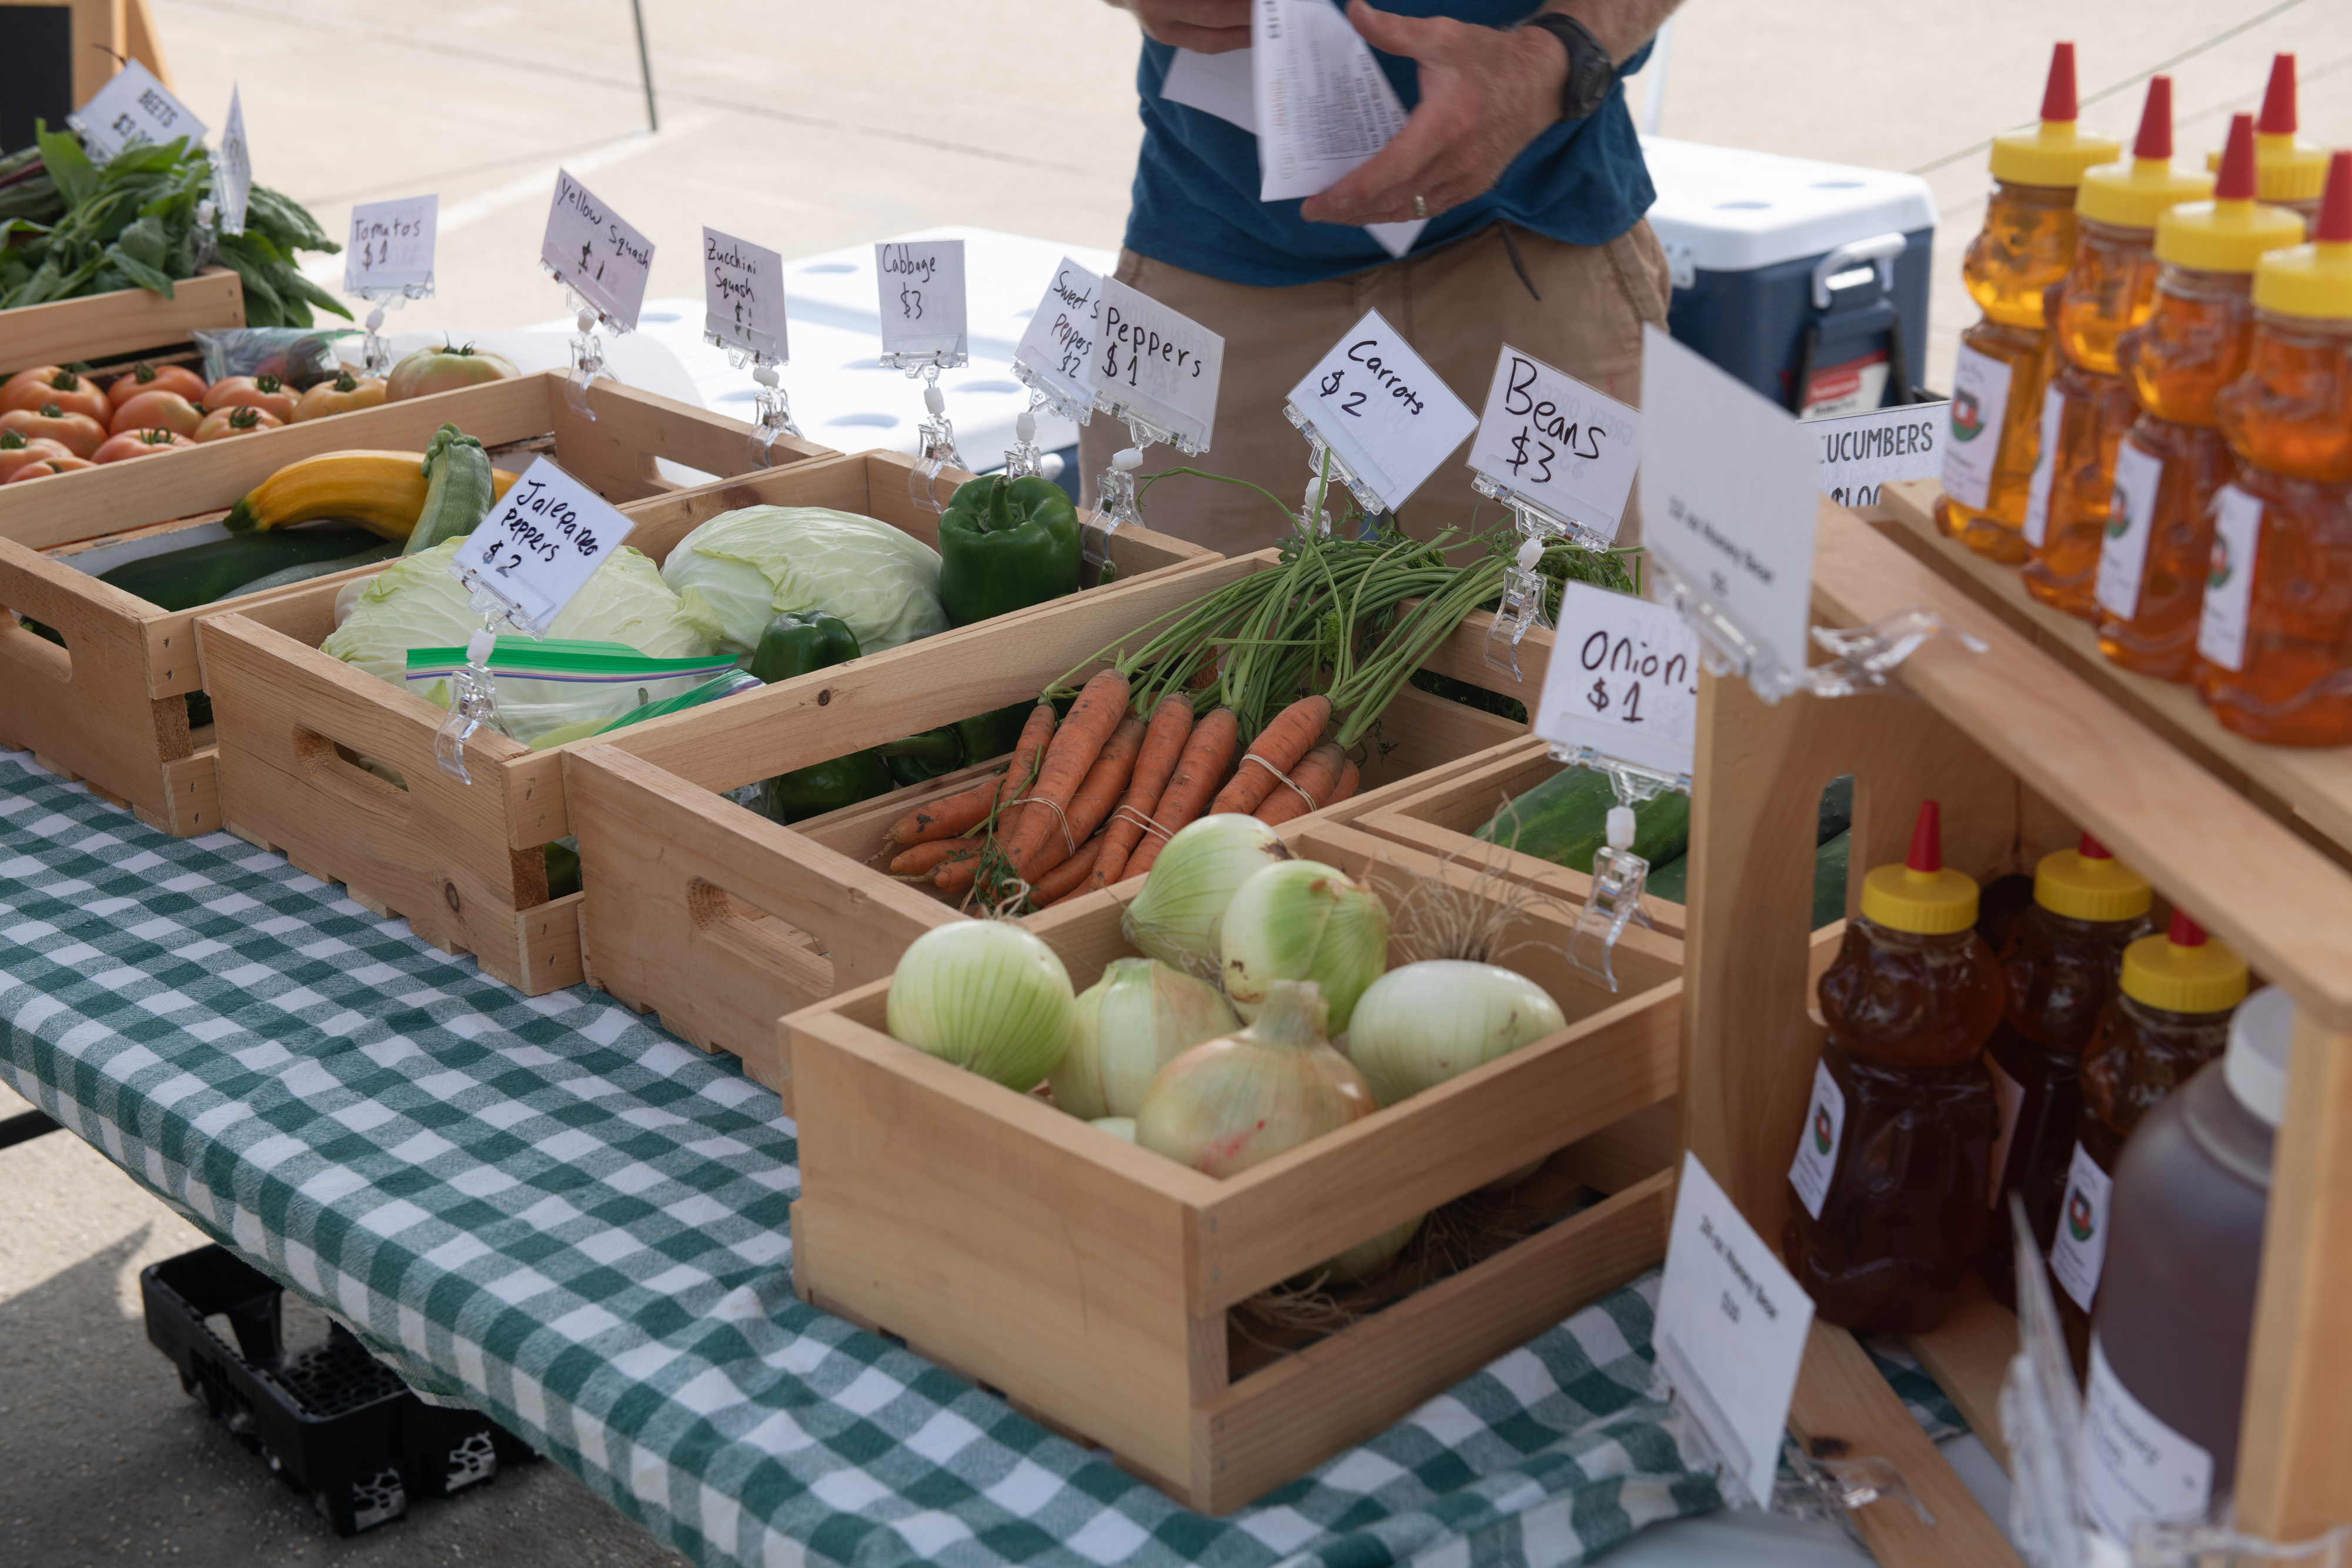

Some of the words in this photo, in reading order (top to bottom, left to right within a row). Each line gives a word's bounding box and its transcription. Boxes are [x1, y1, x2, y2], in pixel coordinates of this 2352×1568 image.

[608, 225, 649, 269] Squash
[707, 237, 756, 275] Zucchini
[883, 244, 936, 283] Cabbage
[714, 266, 754, 303] Squash
[900, 282, 923, 319] $3
[1053, 270, 1091, 310] Sweet
[1050, 313, 1093, 355] Peppers
[1106, 306, 1202, 377] Peppers
[1057, 352, 1081, 379] $2
[1347, 340, 1424, 415] Carrots
[1505, 357, 1606, 459] Beans
[1505, 426, 1556, 483] $3
[1819, 422, 1933, 464] UCUMBERS
